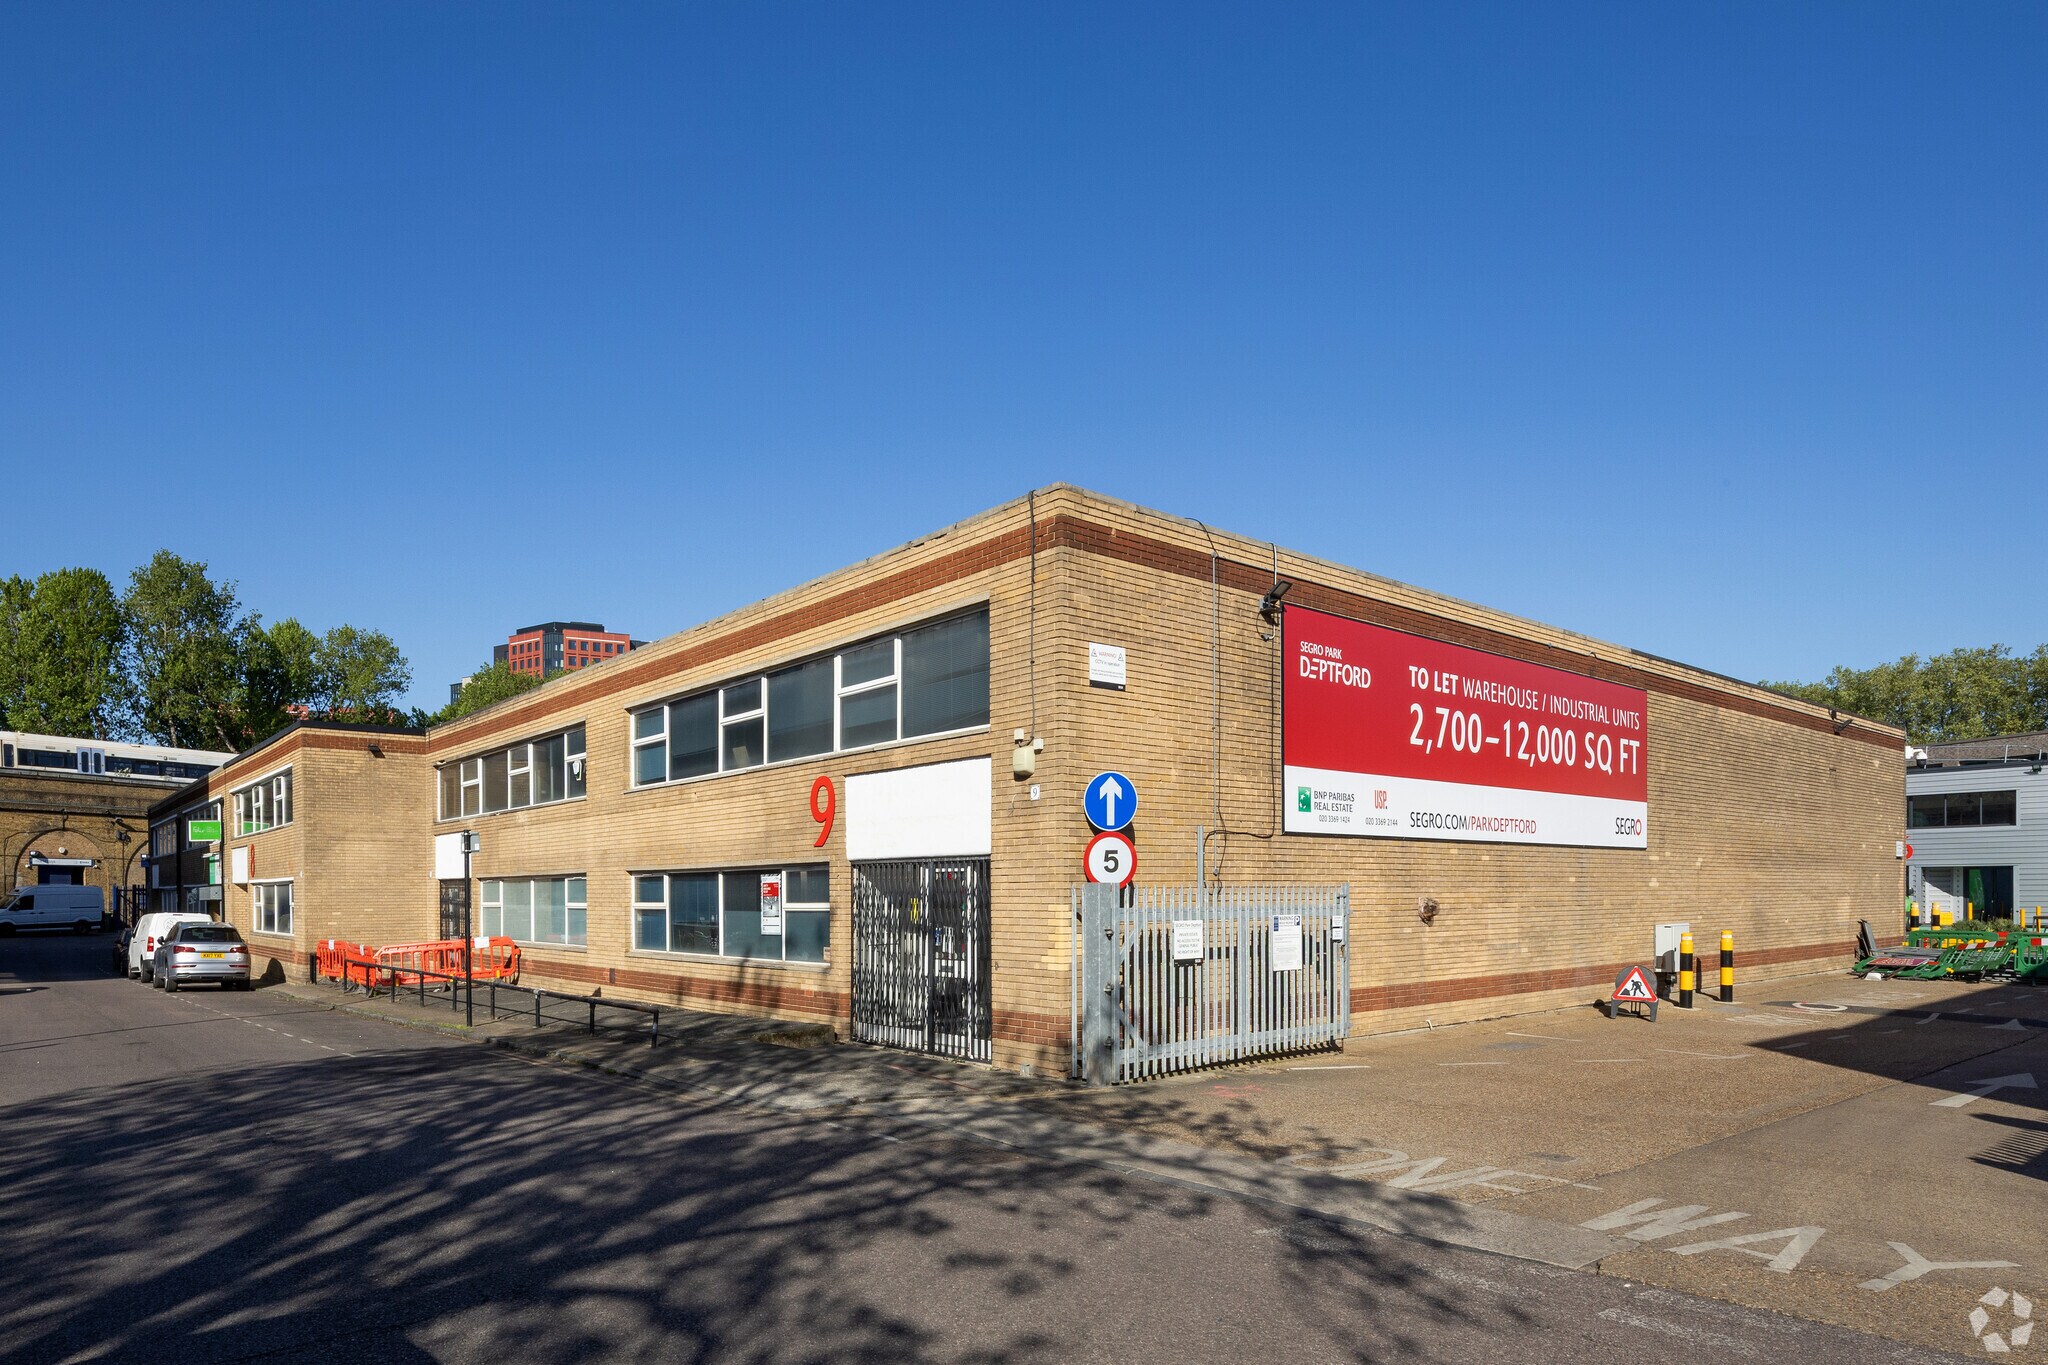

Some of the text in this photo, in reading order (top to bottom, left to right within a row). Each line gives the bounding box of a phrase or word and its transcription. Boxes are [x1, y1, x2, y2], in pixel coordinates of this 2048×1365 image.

[1300, 641, 1342, 659] SEGRO PARK
[1300, 655, 1371, 688] DEPTFORD
[1409, 665, 1429, 689] TO
[1434, 670, 1459, 695] LET
[1463, 676, 1538, 711] WAREHOUSE
[1550, 695, 1610, 724] INDUSTRIAL
[1612, 709, 1640, 730] UNITS
[1584, 731, 1612, 775] SQ
[1620, 738, 1640, 774] FT
[1032, 787, 1038, 797] 9
[1313, 790, 1355, 802] BNP PARIBAS
[810, 775, 836, 847] 9
[1313, 802, 1353, 812] REAL ESTATE
[1328, 815, 1339, 823] 3369
[1365, 817, 1374, 825] 020
[1410, 811, 1537, 834] SEGRO.COM/PARKDEPTFORD
[1615, 817, 1642, 836] SEGRO
[250, 843, 255, 878] 8
[1103, 849, 1119, 873] 5
[1276, 1149, 1604, 1206] ONE
[1579, 1198, 2022, 1292] WAY
